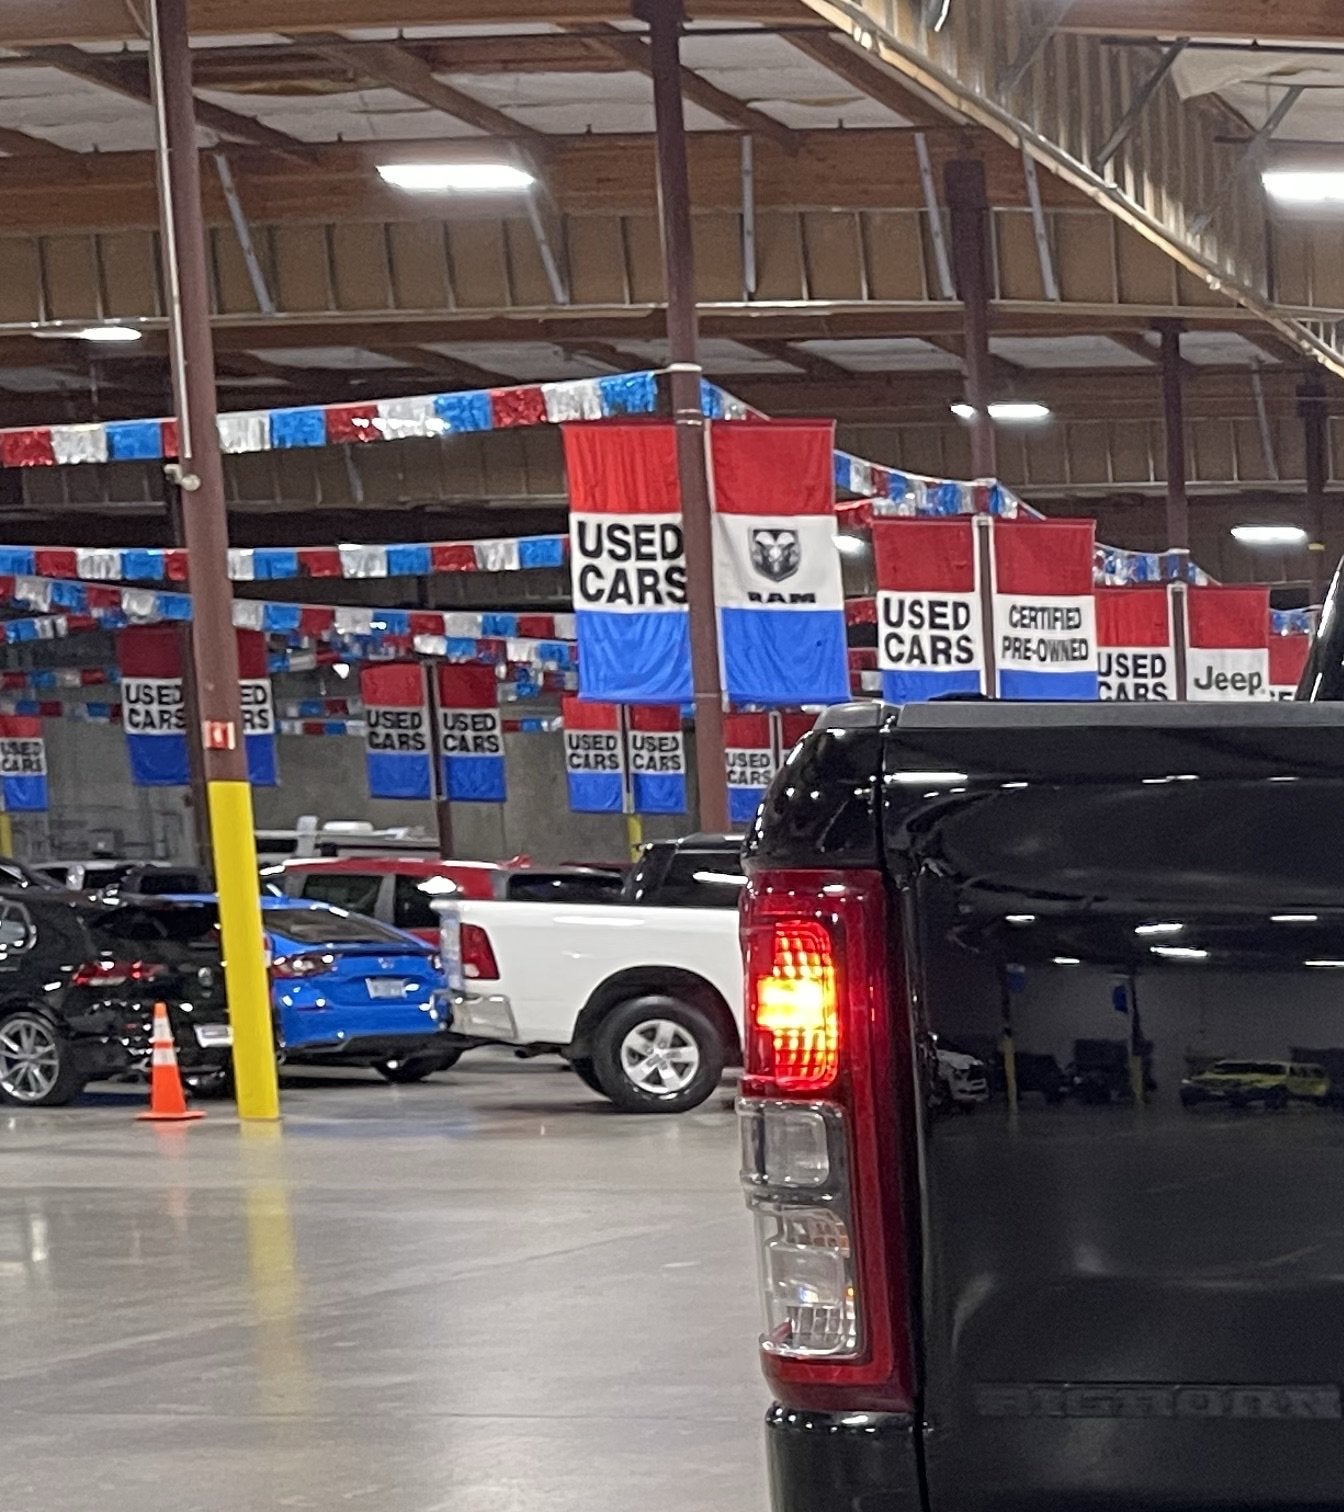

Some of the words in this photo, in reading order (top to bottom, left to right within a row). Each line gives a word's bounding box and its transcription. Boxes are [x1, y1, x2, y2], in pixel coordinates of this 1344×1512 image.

[577, 521, 684, 562] USED
[580, 564, 687, 605] CARS
[883, 598, 970, 631] USED
[1009, 604, 1081, 630] CERTIFIED
[885, 632, 973, 665] CARS
[1002, 636, 1088, 662] PRE-OWNED
[1098, 652, 1167, 678] USED
[1194, 666, 1262, 695] Jeep
[367, 710, 422, 730] USED
[443, 713, 497, 732] USED
[368, 732, 426, 751] CARS
[443, 734, 500, 753] CARS
[568, 734, 618, 750] USED
[632, 735, 680, 751] USED
[569, 753, 620, 770] CARS
[632, 754, 681, 770] CARS
[727, 752, 771, 768] USED
[727, 770, 771, 785] CARS
